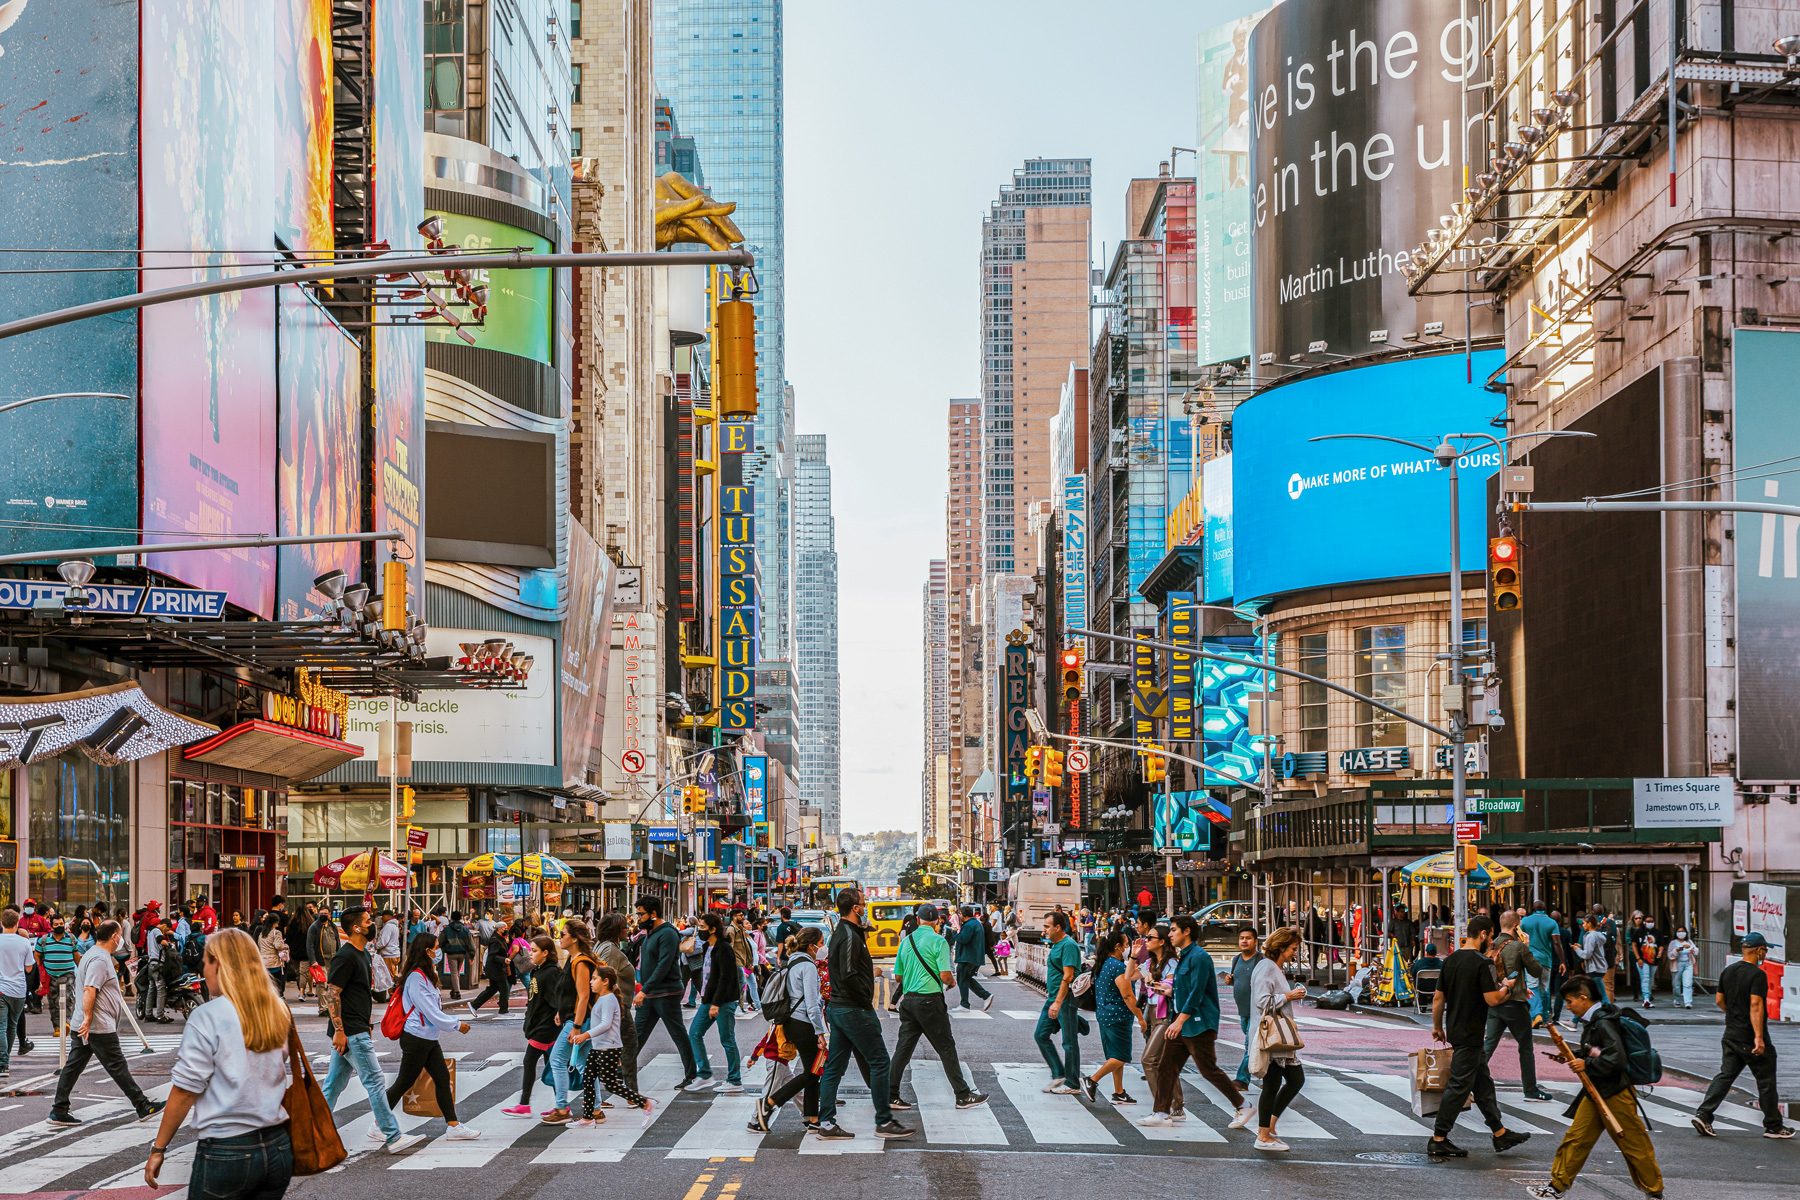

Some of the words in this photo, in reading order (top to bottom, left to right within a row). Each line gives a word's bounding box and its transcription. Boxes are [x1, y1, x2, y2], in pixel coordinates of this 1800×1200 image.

[1287, 56, 1316, 117] is
[1327, 29, 1418, 97] the
[1273, 157, 1299, 217] in
[1310, 130, 1395, 198] the
[1228, 221, 1249, 238] Get
[1202, 270, 1211, 317] business
[1280, 262, 1334, 305] Martin
[1302, 473, 1330, 489] MAKE
[1332, 467, 1367, 484] MORE
[1370, 464, 1388, 479] OF
[1457, 453, 1501, 469] OURS
[1065, 476, 1085, 511] NEW
[0, 583, 136, 611] OUTFONT
[152, 591, 219, 614] PRIME
[726, 485, 750, 728] TUSSAUD'S
[1172, 597, 1191, 685] VICTORY
[1136, 632, 1153, 689] CTORY
[415, 699, 459, 714] tackle
[612, 613, 624, 623] EW
[624, 614, 641, 792] AMSTERD
[1008, 651, 1028, 787] REGAL
[1172, 697, 1192, 738] NEW
[346, 718, 381, 732] lima
[411, 719, 449, 734] risis.
[698, 772, 718, 783] SIX
[1339, 749, 1404, 771] CHASE
[1069, 772, 1081, 829] American
[1479, 799, 1521, 812] Broadway
[1645, 783, 1652, 793] 1
[1654, 782, 1684, 793] Times
[1685, 782, 1721, 795] Square
[1645, 803, 1688, 813] Jamestown
[1689, 802, 1707, 813] OTS,
[1708, 802, 1721, 811] L.P.
